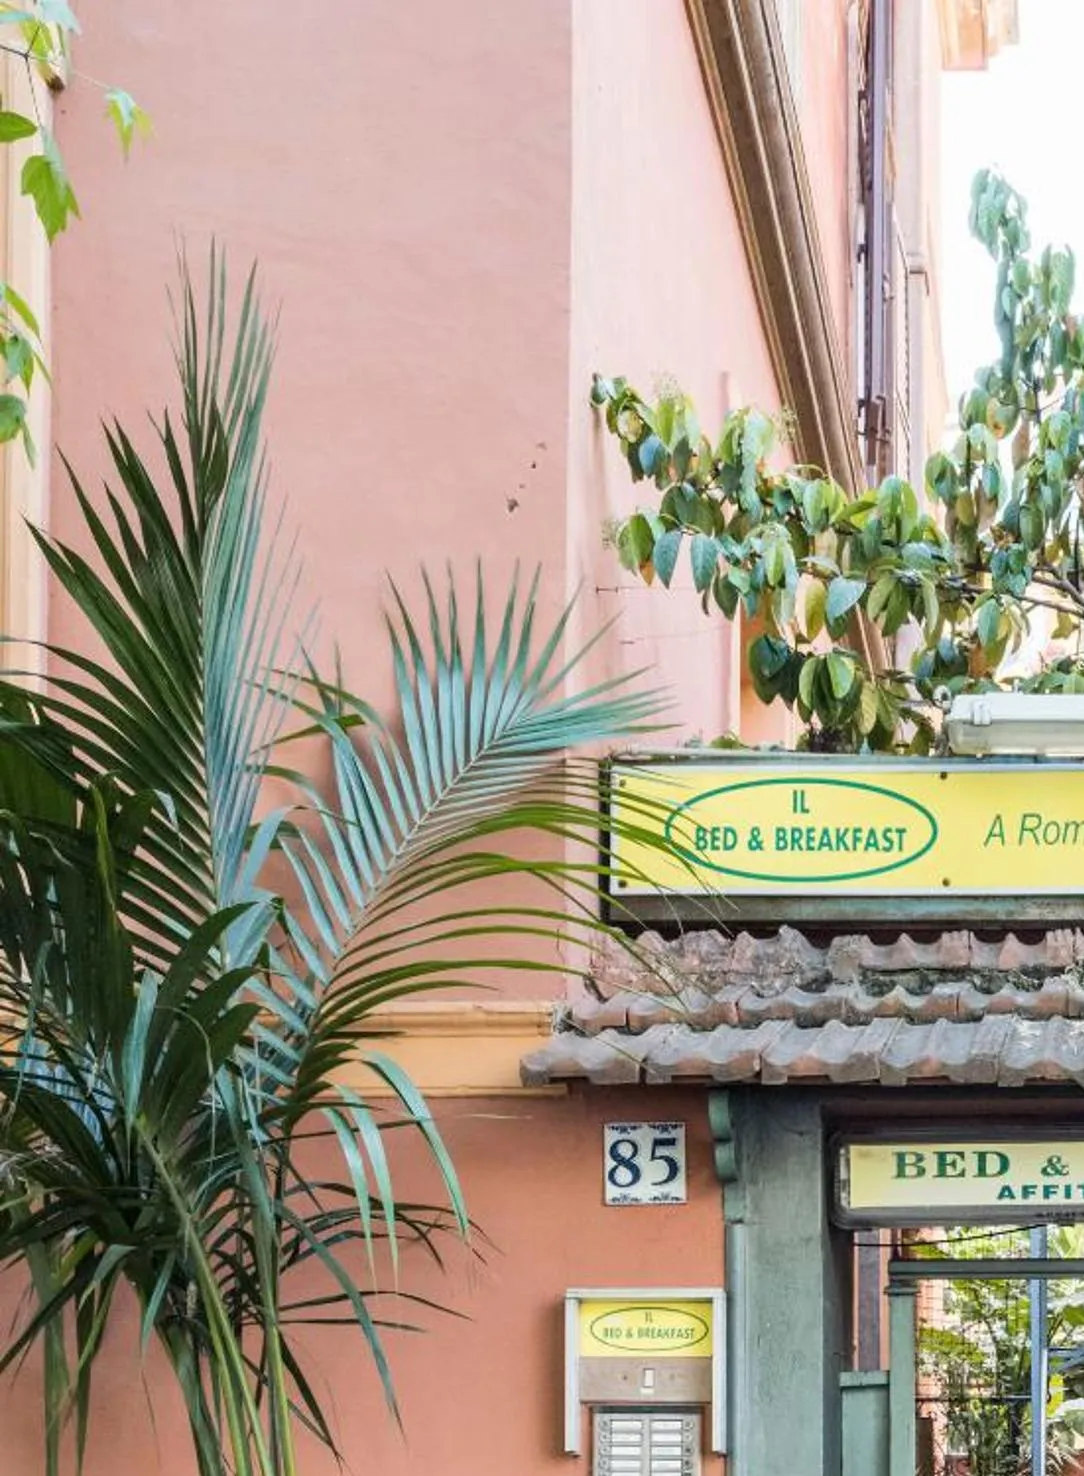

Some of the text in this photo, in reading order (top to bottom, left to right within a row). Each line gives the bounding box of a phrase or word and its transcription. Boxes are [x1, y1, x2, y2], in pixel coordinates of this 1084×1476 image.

[792, 790, 809, 814] IL
[695, 826, 907, 852] BED & BREAKFAST
[984, 814, 1006, 847] A
[607, 1137, 680, 1188] 85
[891, 1150, 1011, 1180] BED
[1040, 1155, 1070, 1177] &
[603, 1327, 622, 1339] BED
[638, 1326, 696, 1340] BREAKFAST
